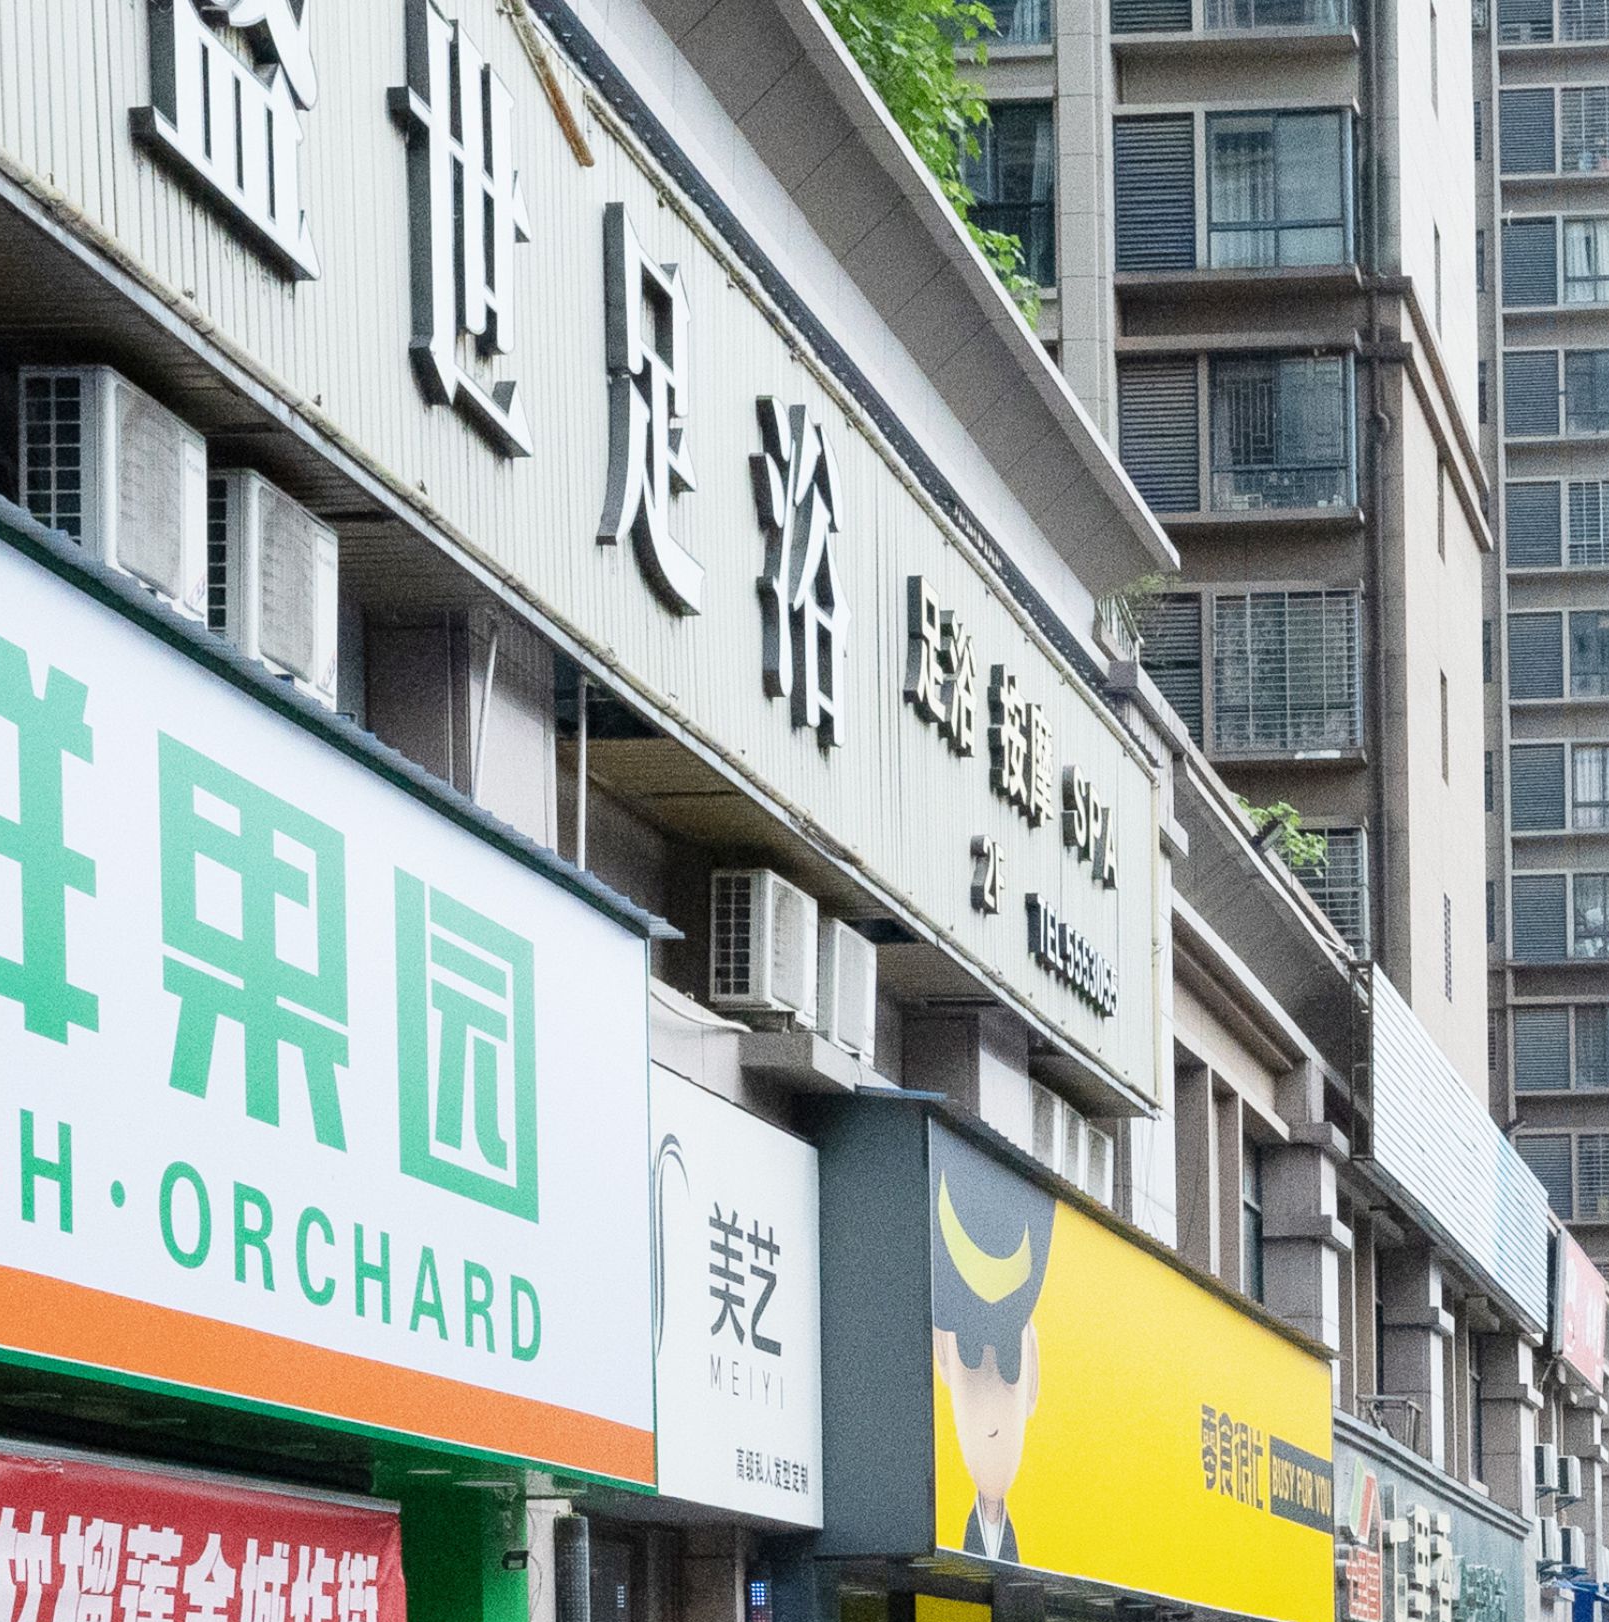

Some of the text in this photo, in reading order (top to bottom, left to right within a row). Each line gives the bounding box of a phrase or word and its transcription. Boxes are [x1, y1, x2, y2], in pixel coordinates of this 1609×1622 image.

[909, 575, 1118, 890] 足浴 按摩 SPA
[981, 834, 1006, 915] 2F
[1035, 892, 1064, 971] TEL
[708, 1201, 782, 1357] 美艺
[710, 1353, 784, 1410] MEIYI
[1201, 1403, 1264, 1511] 零食很忙
[1272, 1454, 1332, 1518] BUSY FOR YOU
